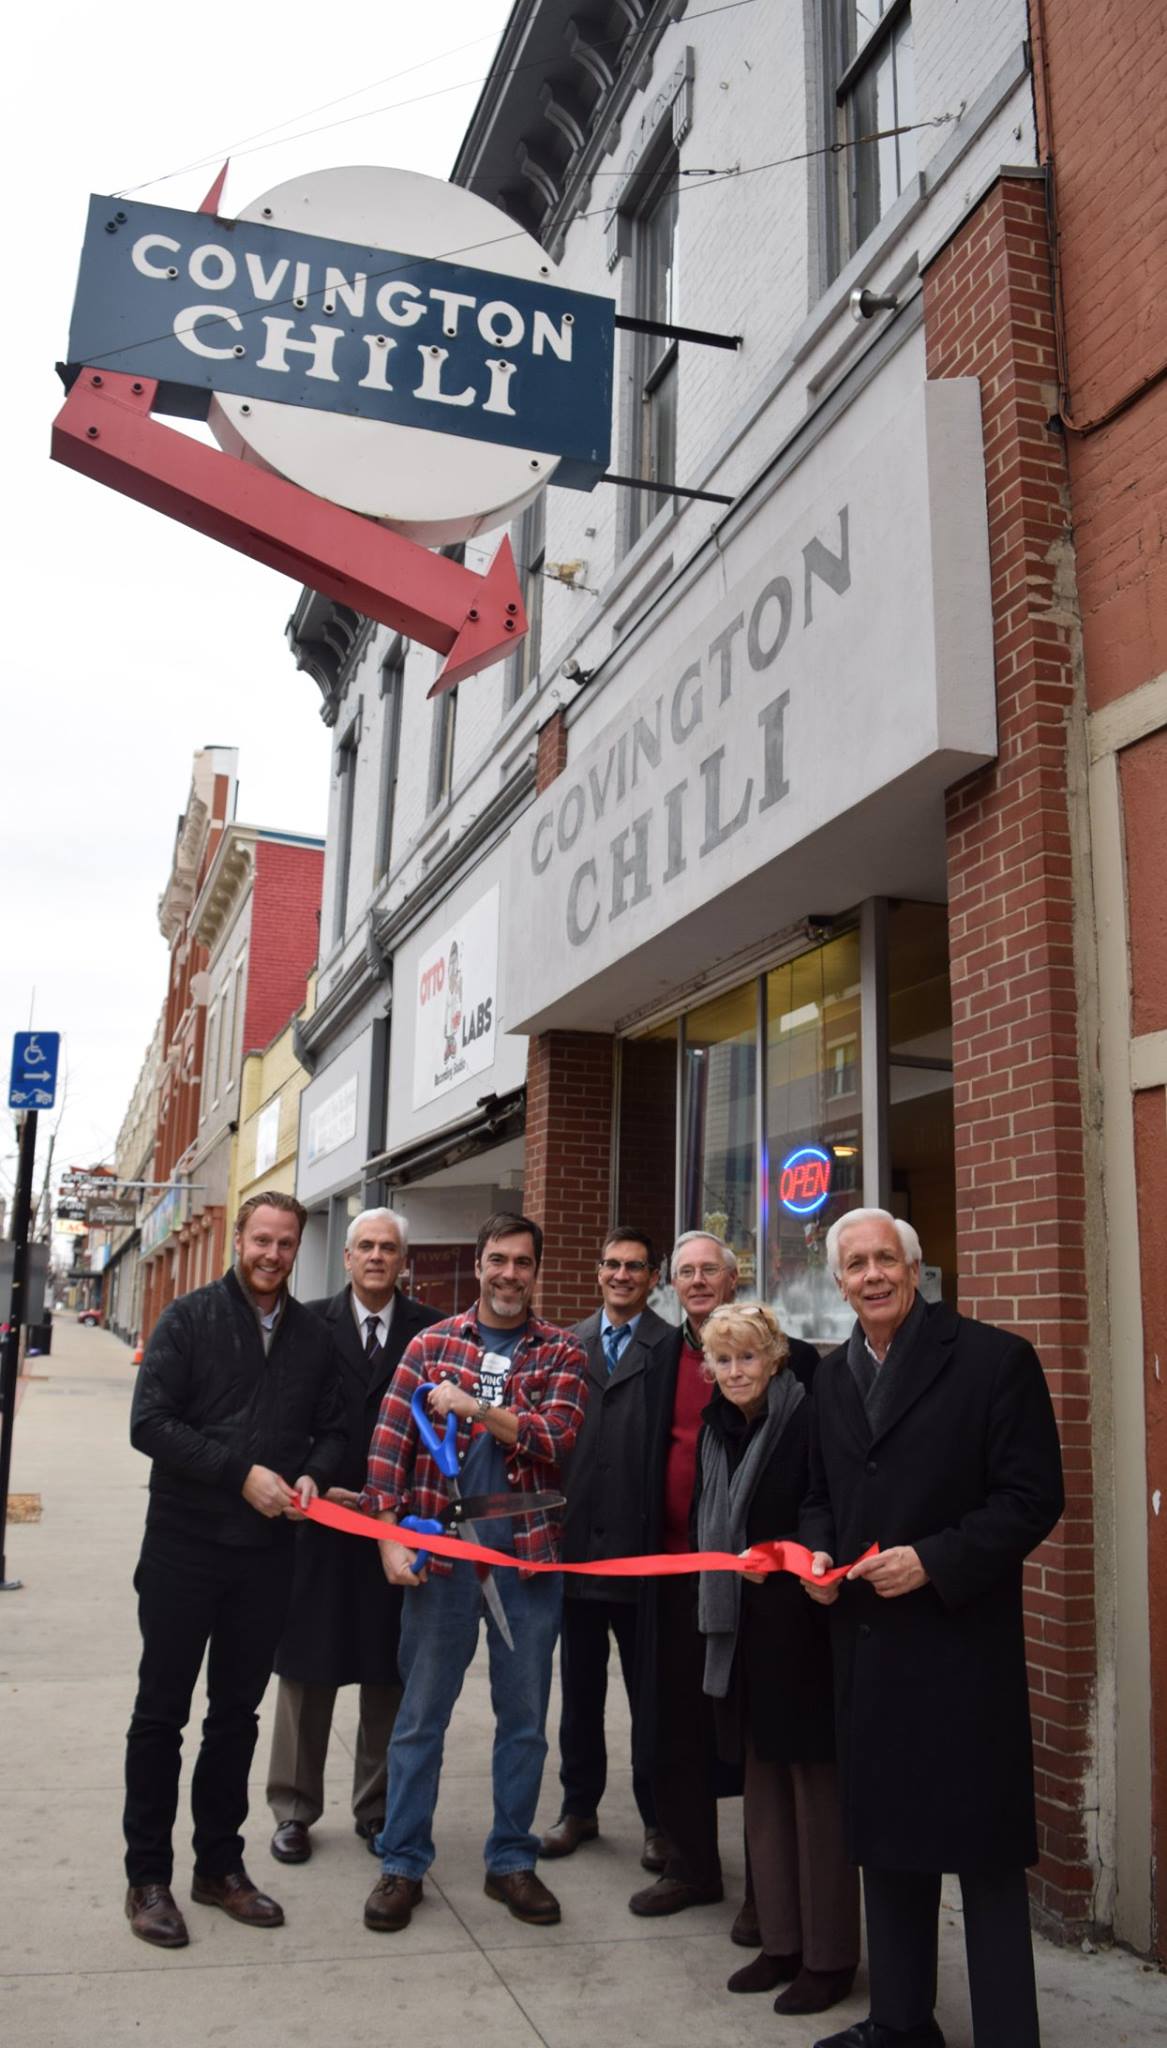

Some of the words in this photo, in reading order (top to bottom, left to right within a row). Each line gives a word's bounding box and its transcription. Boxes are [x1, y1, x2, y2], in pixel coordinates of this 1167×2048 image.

[131, 234, 573, 362] COVINGTON
[173, 305, 517, 416] CHILI
[530, 504, 853, 876] COVINGTON
[566, 688, 791, 947] CHILI
[420, 957, 445, 1006] OTTO
[462, 997, 493, 1047] LABS
[780, 1160, 831, 1201] OPEN
